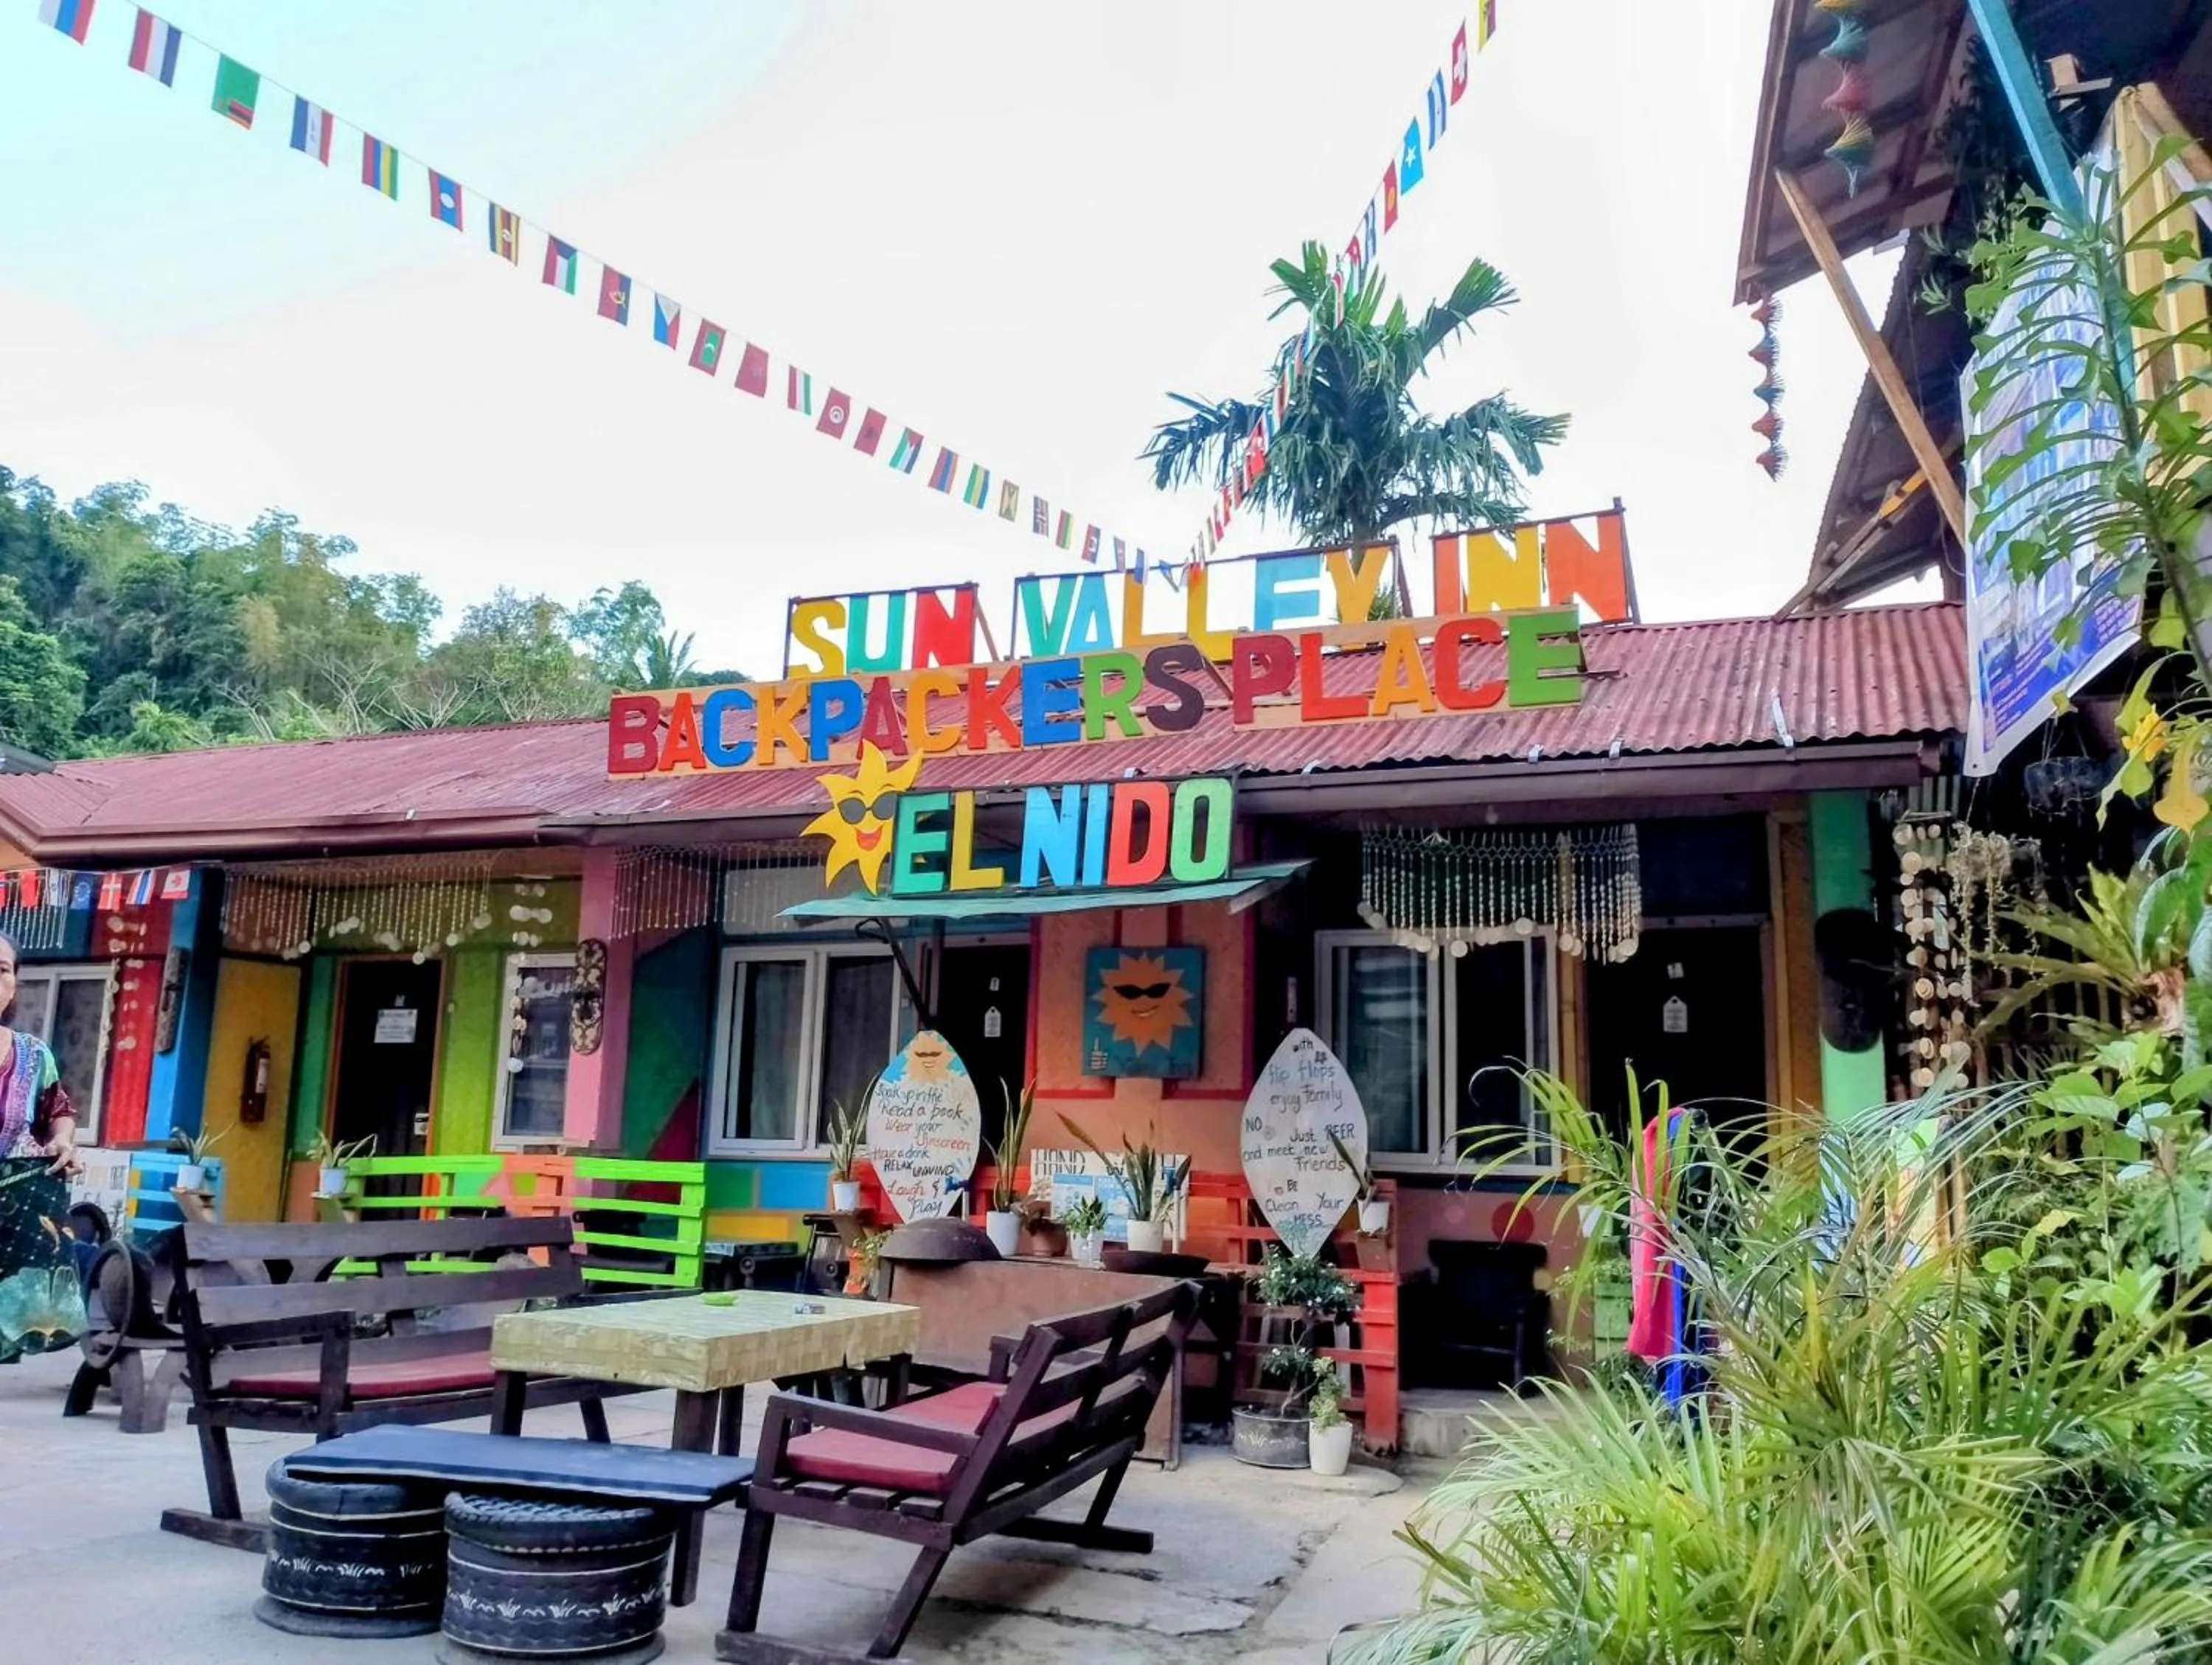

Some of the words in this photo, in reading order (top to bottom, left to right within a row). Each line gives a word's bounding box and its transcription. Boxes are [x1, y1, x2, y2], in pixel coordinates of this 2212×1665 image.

[785, 584, 977, 678] SUN
[1018, 546, 1391, 660] VALLEY
[1433, 515, 1627, 624] INN
[607, 643, 1206, 774] BACKPACKERS
[1233, 608, 1582, 726] PLACE
[891, 790, 1005, 895] EL
[1019, 778, 1233, 889] NIDO
[917, 1106, 926, 1116] a
[1245, 1116, 1262, 1133] NO
[1034, 1149, 1086, 1176] HAND
